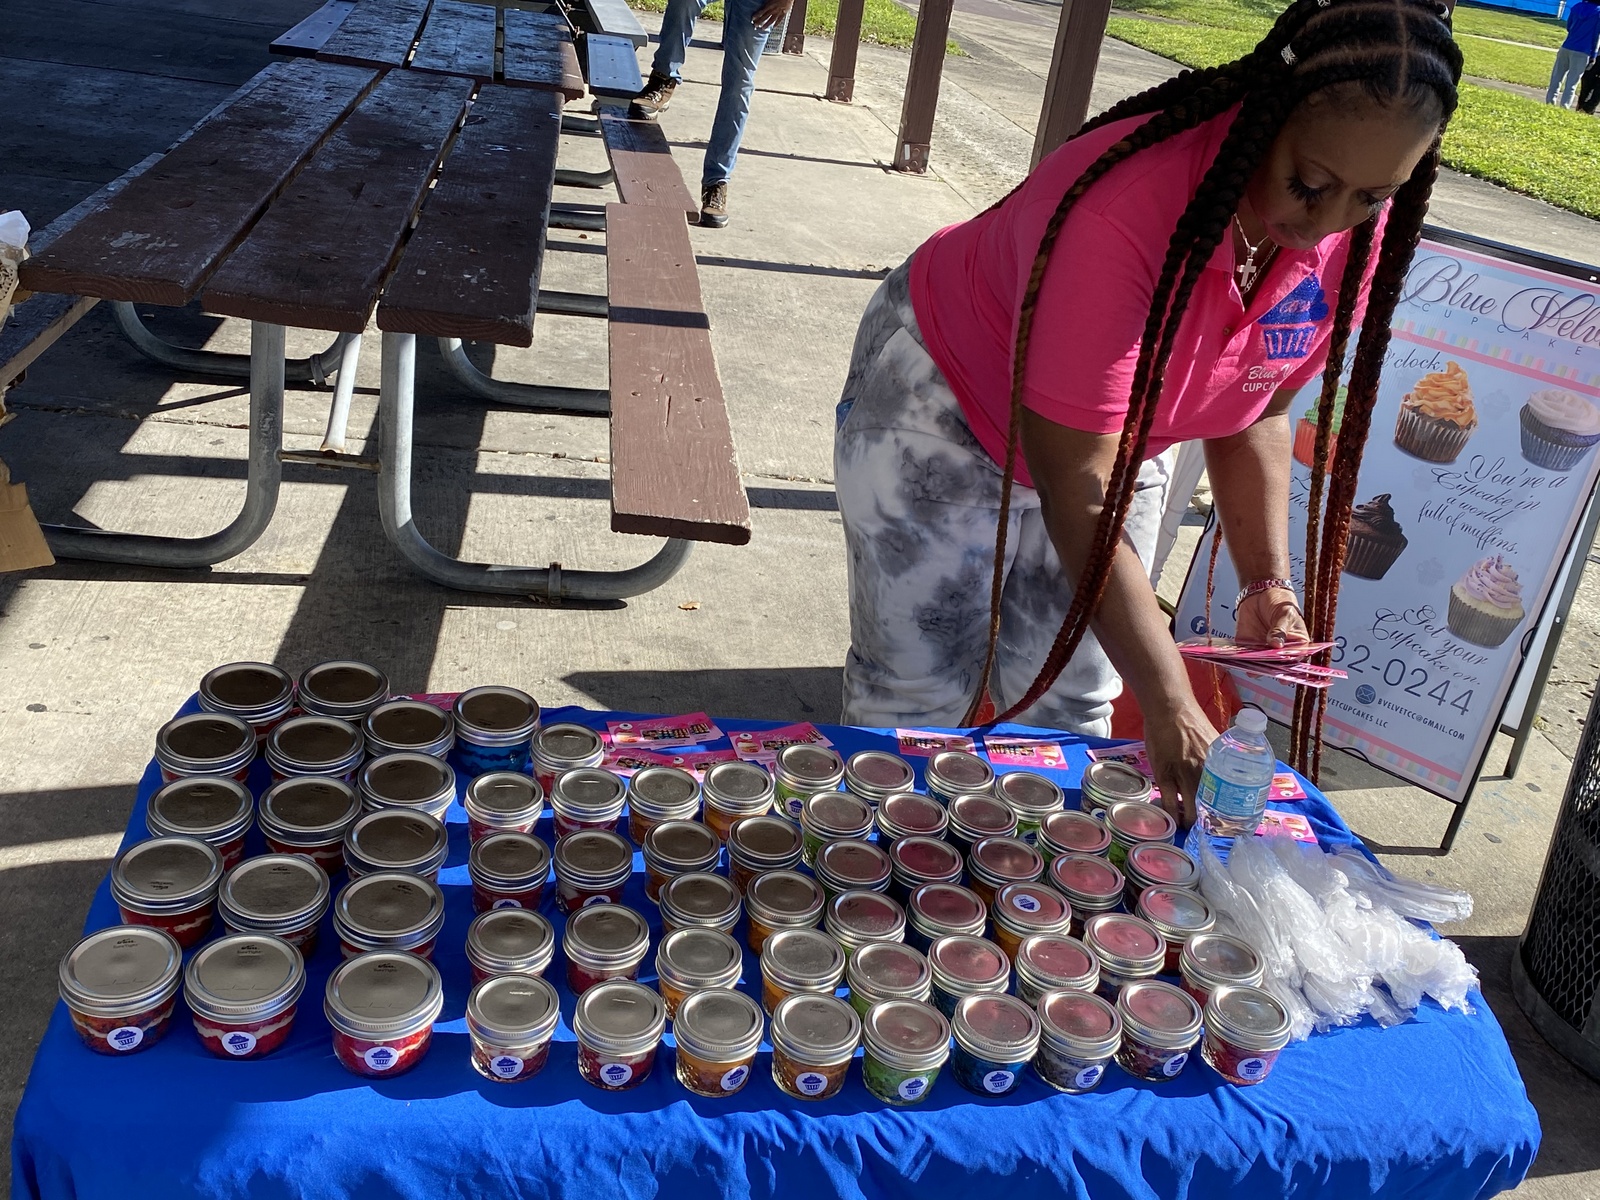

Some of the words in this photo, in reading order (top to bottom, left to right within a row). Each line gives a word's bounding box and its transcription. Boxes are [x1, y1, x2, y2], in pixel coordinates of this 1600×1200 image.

[1399, 255, 1498, 315] Blue
[1502, 287, 1600, 347] Velv
[1247, 365, 1279, 380] Blue
[1431, 467, 1514, 508] Cupcake
[1514, 495, 1543, 512] in
[1464, 454, 1546, 489] You're
[1548, 474, 1570, 489] a
[1417, 500, 1450, 524] full
[1446, 512, 1463, 536] of
[1460, 521, 1519, 555] muffins.
[1446, 496, 1457, 504] a
[1458, 501, 1514, 525] world
[1367, 607, 1450, 673] Cupcake
[1452, 670, 1481, 686] on.
[1403, 604, 1448, 639] Get
[1435, 637, 1489, 665] your
[1375, 716, 1389, 729] LLC
[1377, 697, 1466, 741] BVELVETCC@GMAIL.COM
